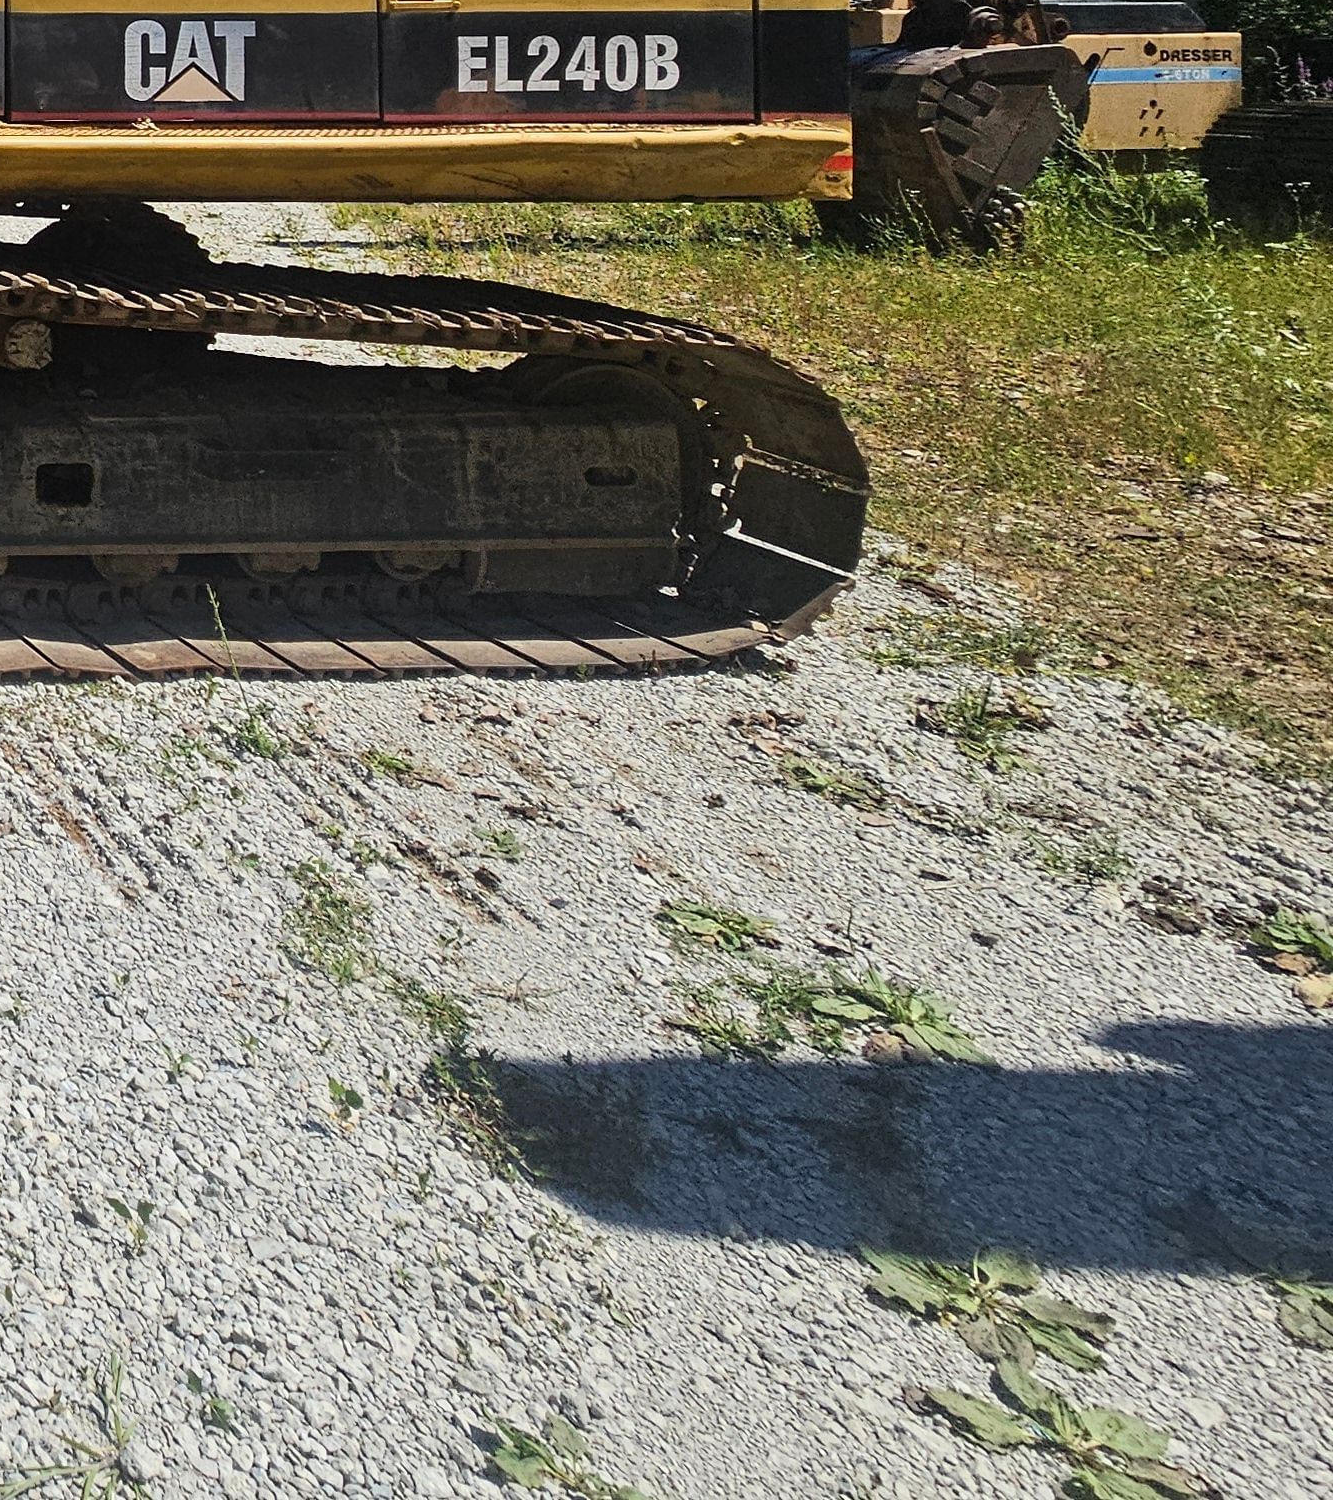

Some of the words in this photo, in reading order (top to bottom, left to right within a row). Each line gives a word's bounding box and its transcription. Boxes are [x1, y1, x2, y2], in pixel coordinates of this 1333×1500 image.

[124, 19, 256, 101] CAT
[457, 35, 680, 92] EL240B
[1160, 49, 1233, 62] DRESSER
